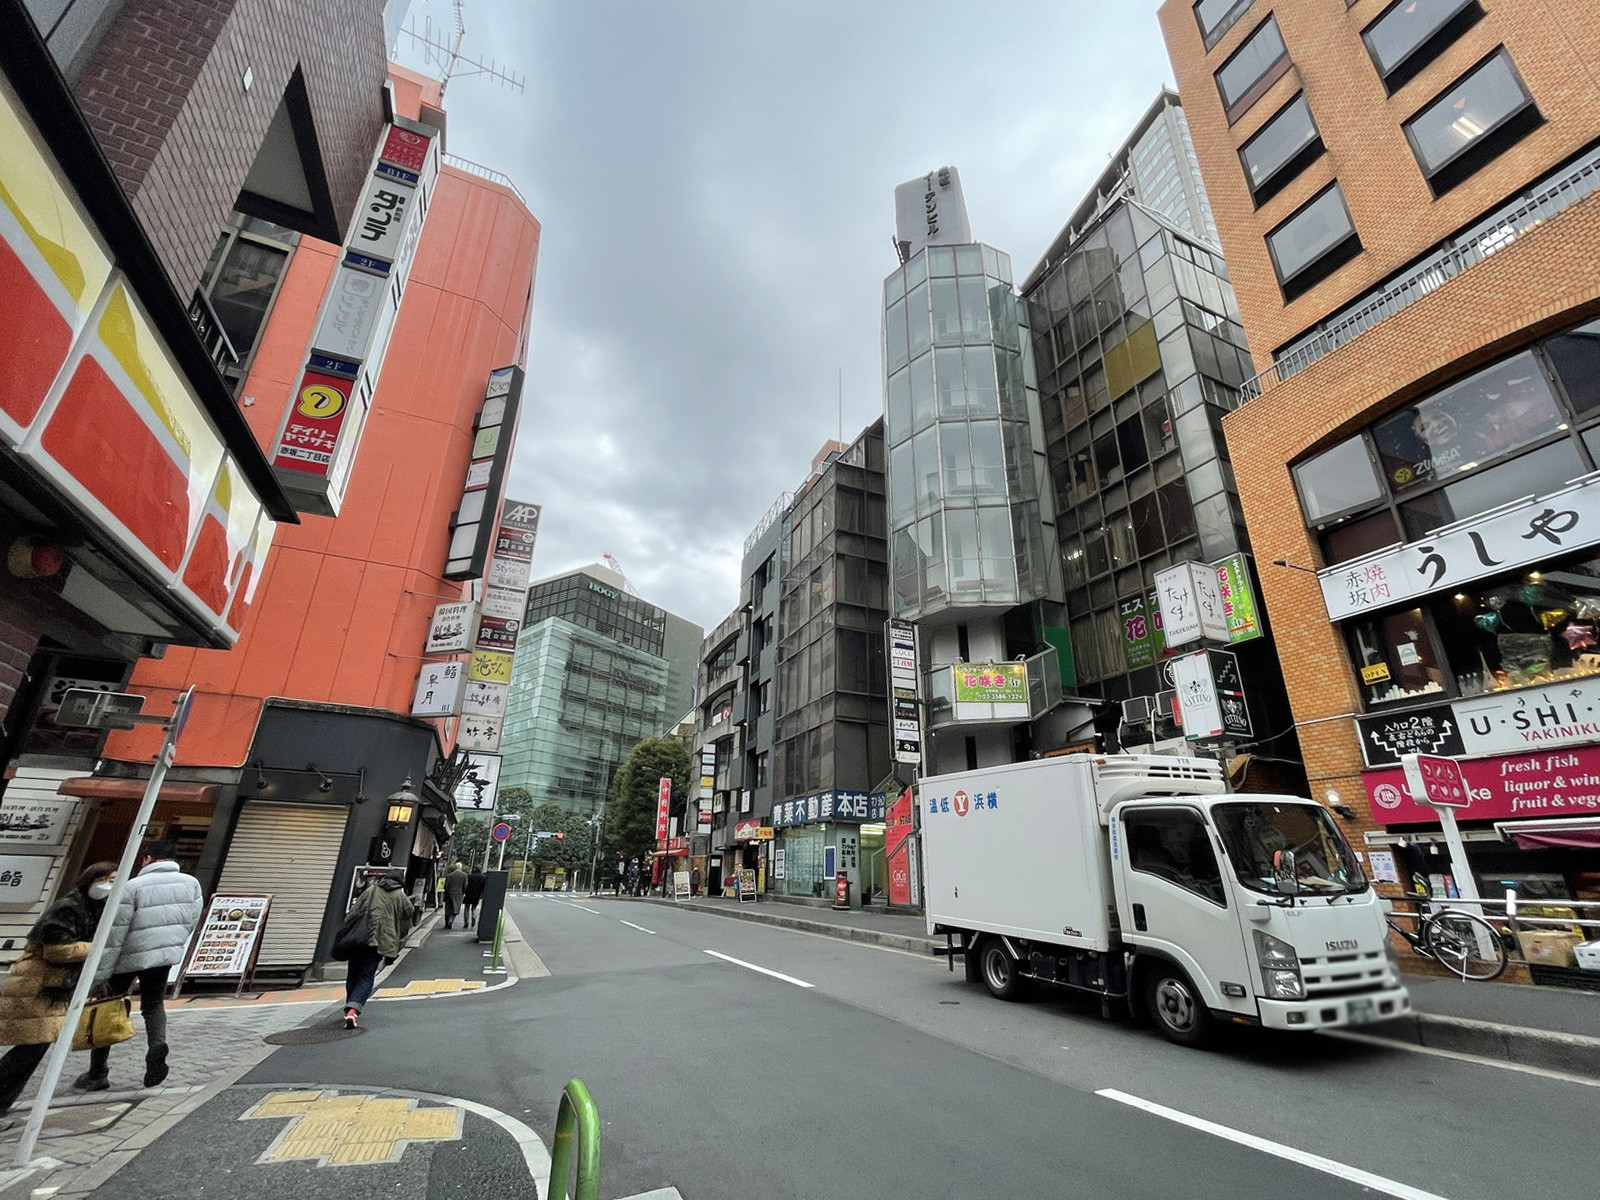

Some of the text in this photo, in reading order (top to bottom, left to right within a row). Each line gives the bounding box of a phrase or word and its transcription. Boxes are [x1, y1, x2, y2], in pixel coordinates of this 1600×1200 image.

[360, 258, 376, 269] 2F
[325, 360, 343, 371] 2F
[290, 424, 335, 438] デイリー
[284, 432, 335, 449] ヤマザキ
[280, 446, 330, 463] 赤坂二丁目店
[1416, 508, 1579, 588] うしや
[588, 581, 619, 599] HOGY
[1345, 571, 1371, 607] 赤坂
[1363, 564, 1391, 602] 焼肉
[1364, 669, 1387, 679] OPEN
[1500, 754, 1579, 777] fresh fish
[1504, 780, 1550, 794] liquor
[1553, 776, 1567, 789] &
[773, 793, 868, 825] 青葉不動産 本店
[1510, 797, 1548, 813] fruit
[1551, 793, 1565, 806] &
[1326, 939, 1358, 951] ISUZU
